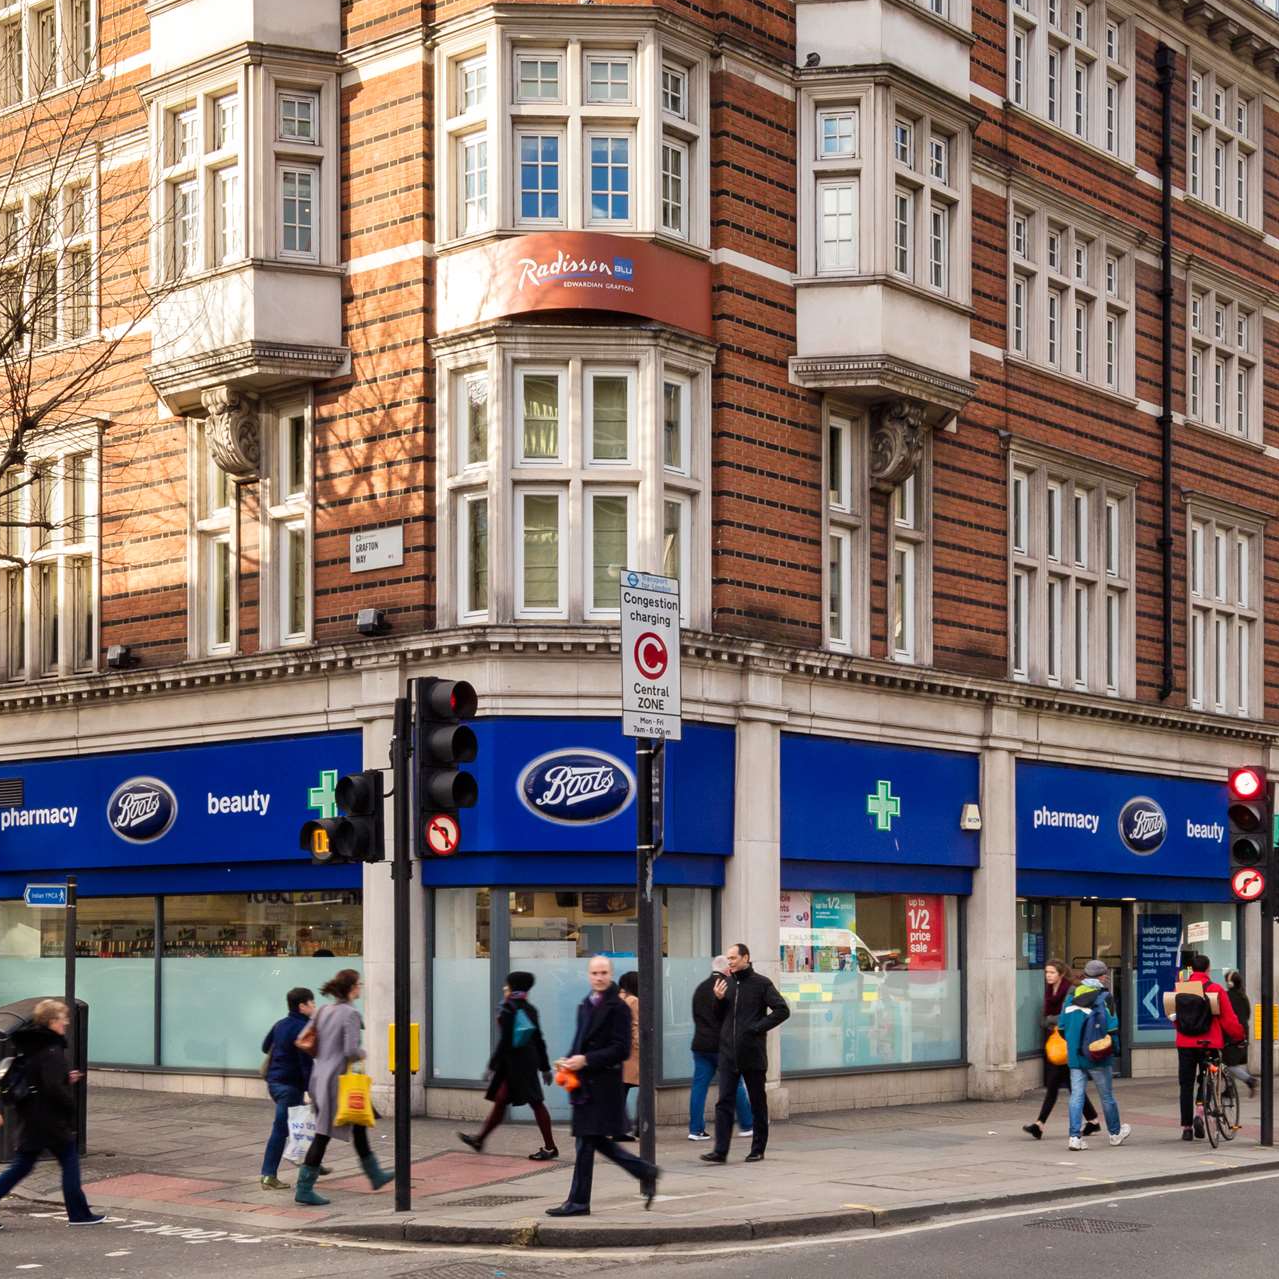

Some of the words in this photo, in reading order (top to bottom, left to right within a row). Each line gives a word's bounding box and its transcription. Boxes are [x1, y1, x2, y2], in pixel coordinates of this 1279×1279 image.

[519, 250, 612, 289] Radisson
[605, 283, 634, 293] GRAFTON
[355, 541, 379, 553] GRAFTON
[356, 555, 367, 564] WAY
[641, 574, 668, 585] Transport
[623, 592, 678, 611] Congestion
[630, 610, 671, 627] charging
[634, 682, 669, 697] Central
[637, 697, 665, 711] ZONE
[640, 716, 651, 725] Mon
[656, 718, 664, 726] Fri
[535, 765, 614, 806] Boots
[1, 806, 78, 831] pharmacy
[113, 792, 160, 827] Boots
[207, 789, 271, 816] beauty
[1033, 806, 1099, 834] pharmacy
[1129, 809, 1165, 840] Boots
[1187, 819, 1224, 842] beauty
[908, 899, 918, 907] up
[908, 909, 930, 930] 1/2
[910, 930, 931, 942] price
[1142, 926, 1177, 935] welcome
[910, 943, 928, 953] sale
